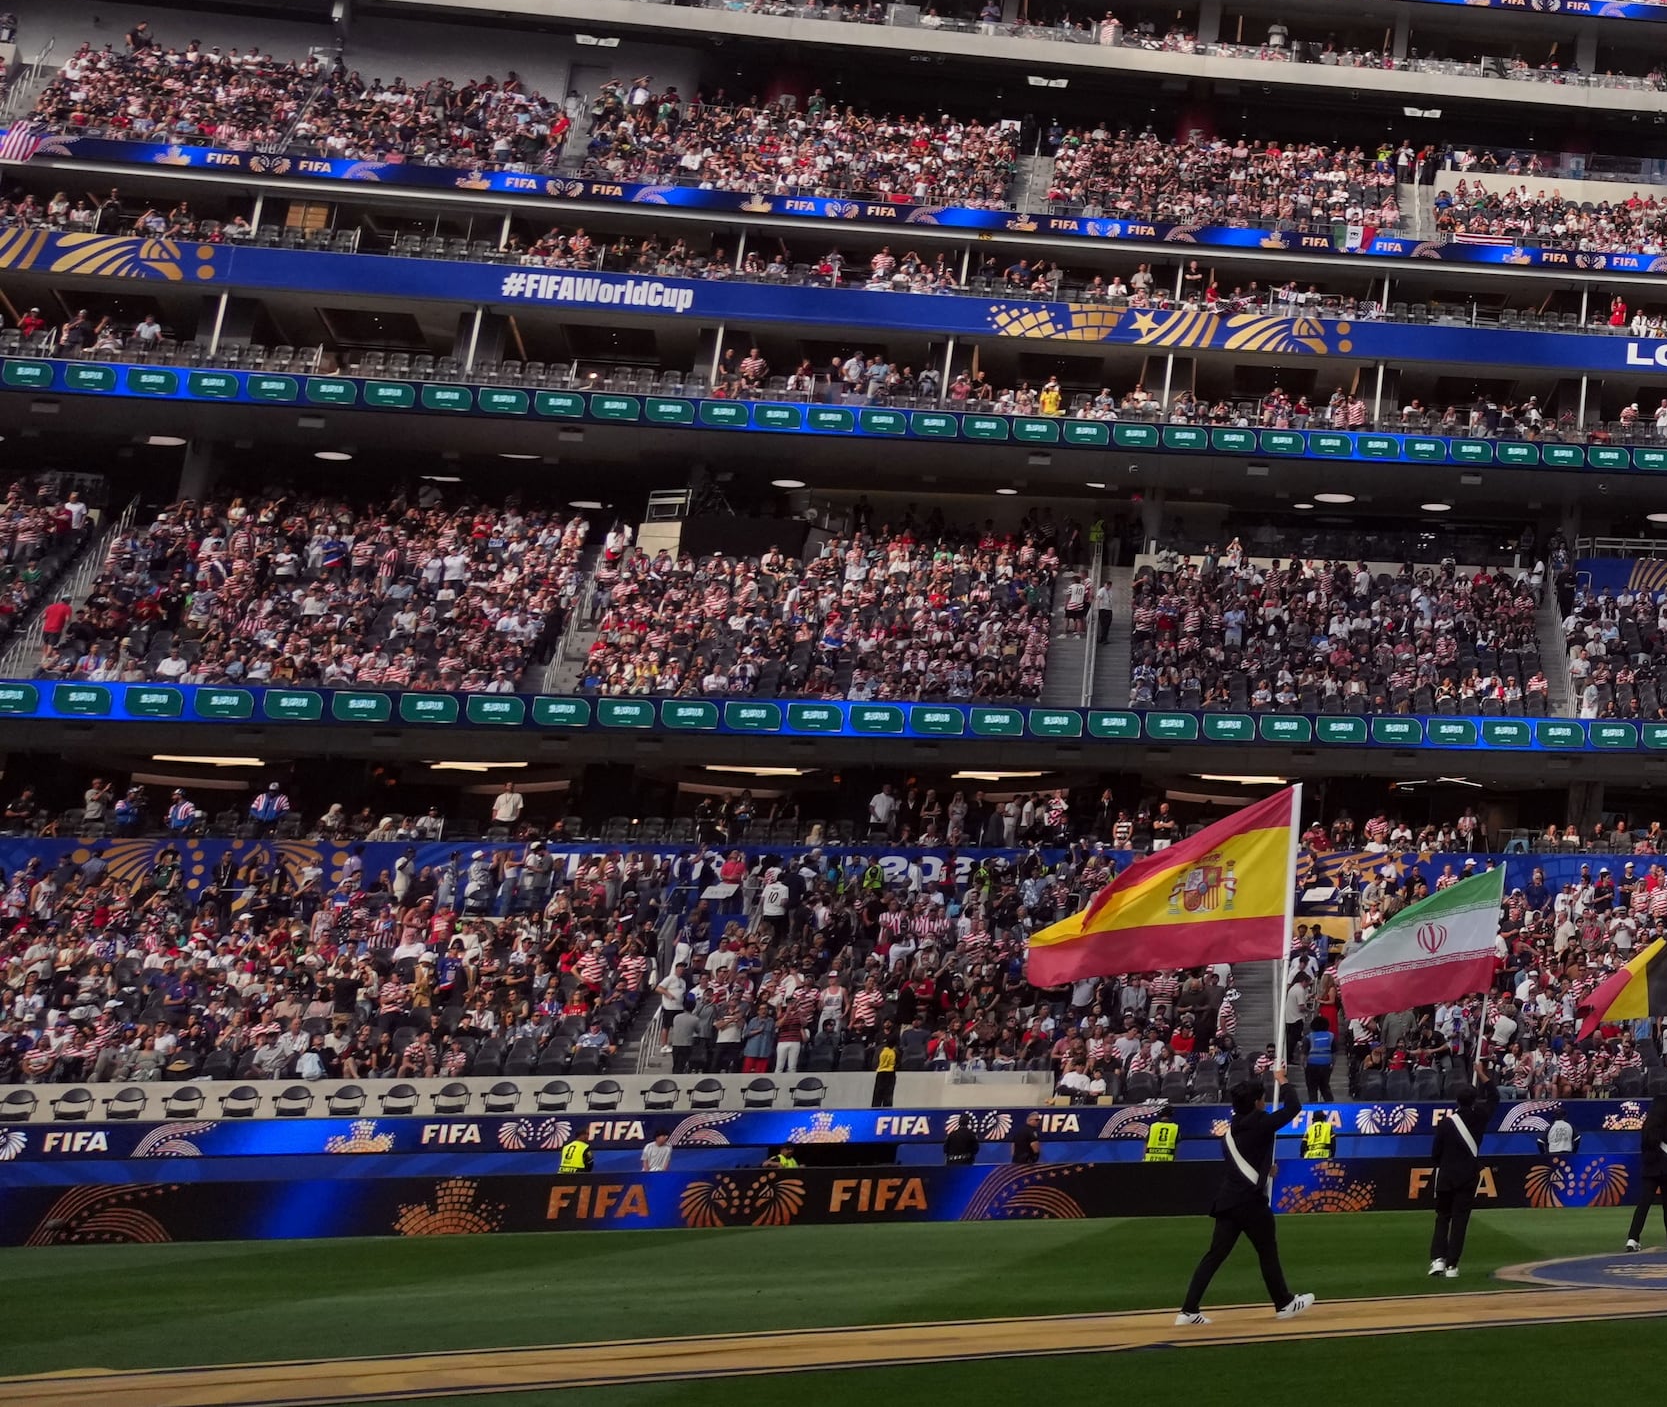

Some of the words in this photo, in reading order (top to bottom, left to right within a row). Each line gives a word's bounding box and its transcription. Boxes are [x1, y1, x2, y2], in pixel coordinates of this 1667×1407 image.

[1567, 1, 1590, 11] FIFA
[206, 153, 240, 165] FIFA
[299, 161, 331, 172] FIFA
[505, 177, 537, 189] FIFA
[592, 185, 622, 196] FIFA
[786, 200, 815, 211] FIFA
[867, 206, 896, 217] FIFA
[1050, 219, 1078, 230] FIFA
[1128, 225, 1155, 236] FIFA
[1302, 237, 1328, 247] FIFA
[1376, 242, 1402, 252] FIFA
[1542, 253, 1568, 263] FIFA
[1613, 257, 1638, 267] FIFA
[501, 272, 694, 312] #FIFAWorldCup
[1292, 1110, 1342, 1129] FIA
[588, 1121, 644, 1140] FIFA
[876, 1116, 929, 1135] FIFA
[422, 1124, 481, 1144] FIFA
[44, 1132, 107, 1152] FIFA
[1409, 1167, 1497, 1198] FA
[829, 1178, 927, 1212] FIFA
[547, 1185, 648, 1219] FIFA
